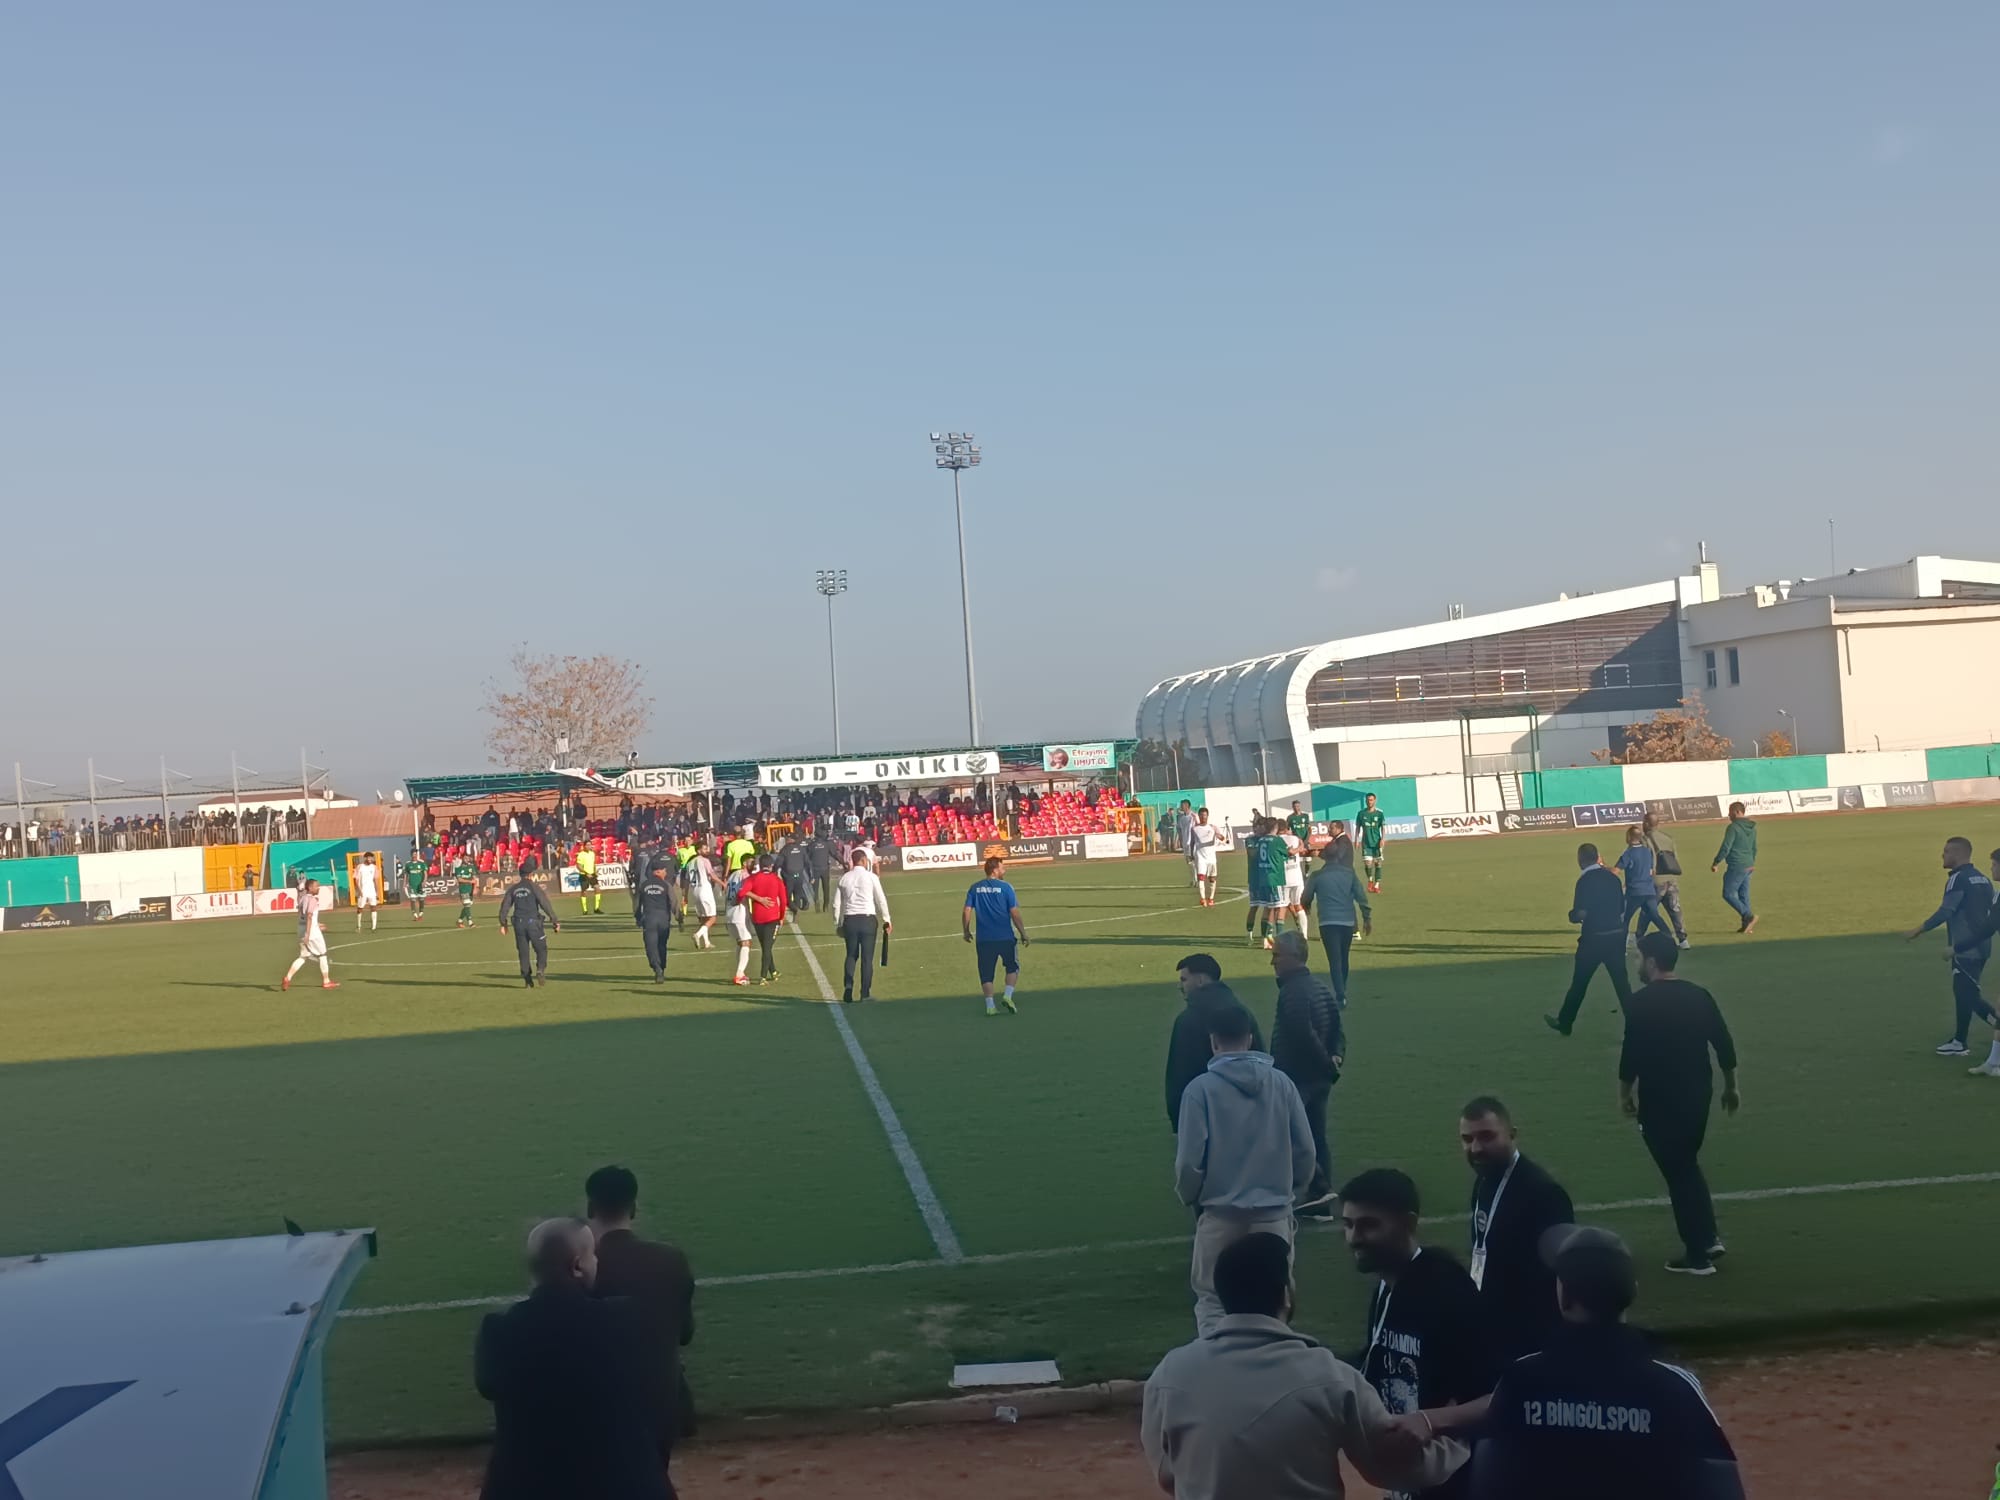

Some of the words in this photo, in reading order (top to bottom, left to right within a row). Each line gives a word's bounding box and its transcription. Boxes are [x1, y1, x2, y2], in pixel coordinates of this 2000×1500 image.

[770, 766, 827, 783] KOD
[1431, 815, 1492, 829] SEKVAN
[1523, 1401, 1542, 1425] 12
[1546, 1398, 1651, 1433] BİNGÖLSPOR
